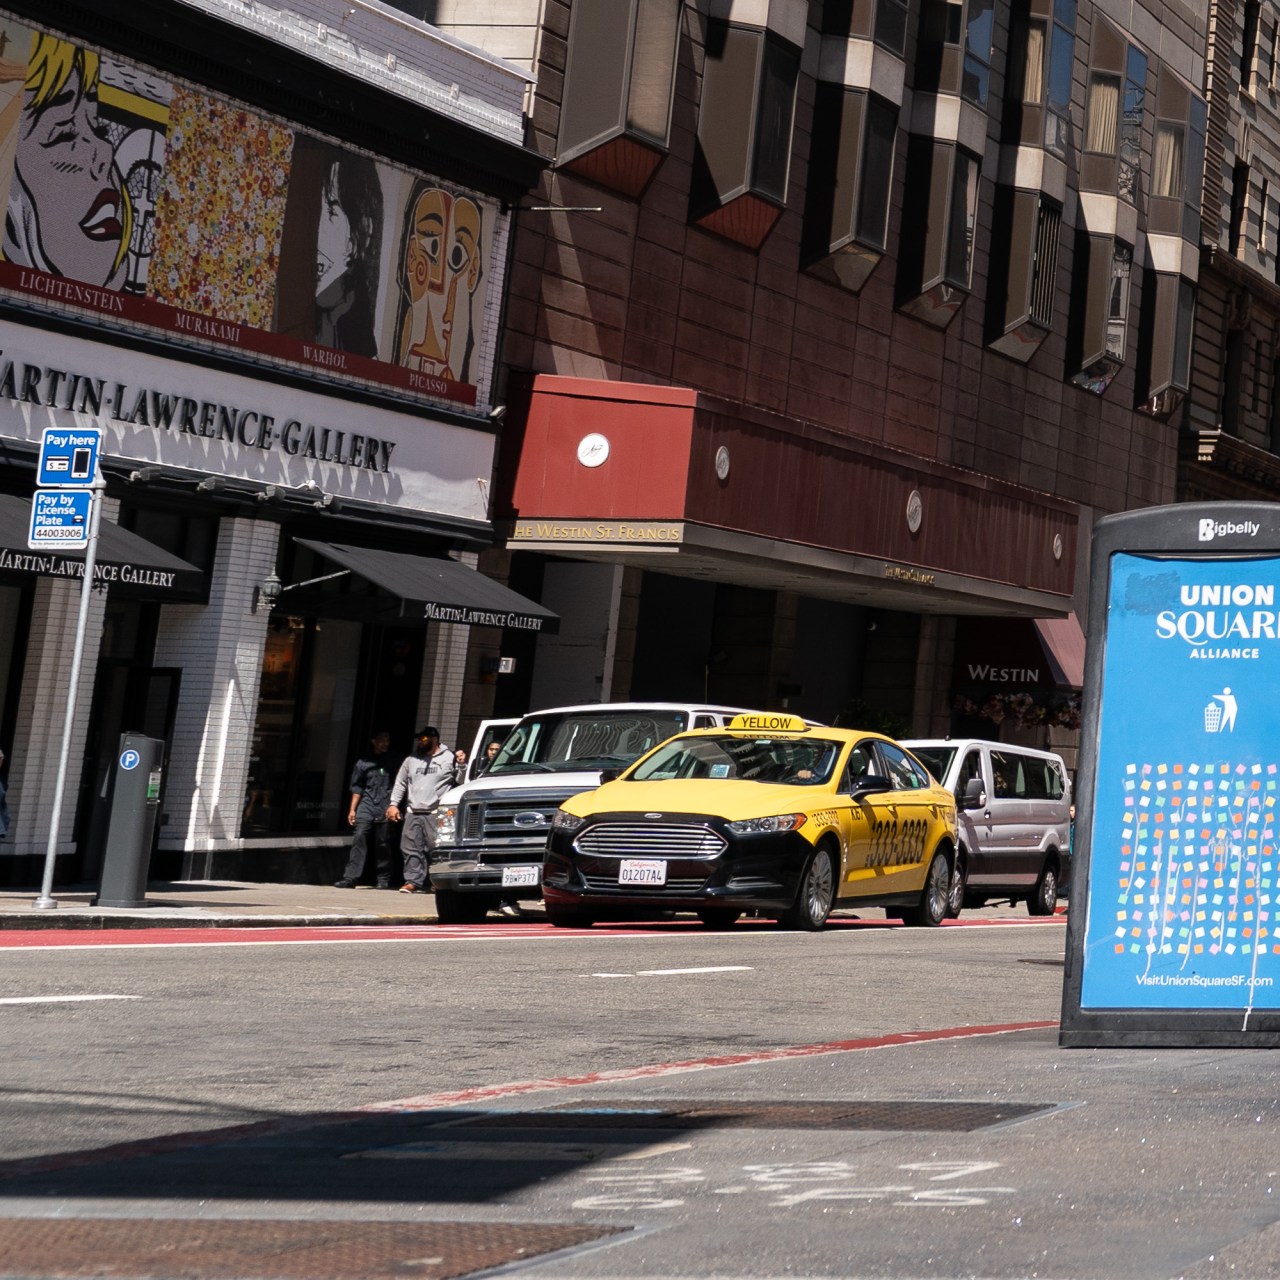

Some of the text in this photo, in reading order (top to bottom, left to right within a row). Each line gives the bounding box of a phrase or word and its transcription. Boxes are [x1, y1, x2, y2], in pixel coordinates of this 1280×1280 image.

[19, 271, 125, 313] LICHTENSTEIN
[174, 312, 241, 343] MURAKAMI
[302, 345, 348, 370] WARHOL
[408, 373, 447, 394] PICASSO
[46, 434, 96, 448] Pay here
[38, 494, 74, 506] Pay by
[37, 505, 76, 515] License
[36, 516, 63, 526] Plate
[1198, 518, 1260, 542] Bigbelly
[36, 529, 82, 538] 44003006
[514, 525, 533, 538] HE
[536, 523, 592, 539] WESTIN
[618, 524, 680, 541] FRANCIS
[121, 564, 176, 588] GALLERY
[1180, 584, 1275, 606] UNION
[507, 611, 543, 631] GALLERY
[1189, 648, 1260, 659] ALLIANCE
[967, 663, 1039, 683] WESTIN
[741, 717, 792, 730] YELLOW
[622, 869, 662, 882] 01207A4
[1135, 974, 1273, 987] VisitUnionSquareSF.com
